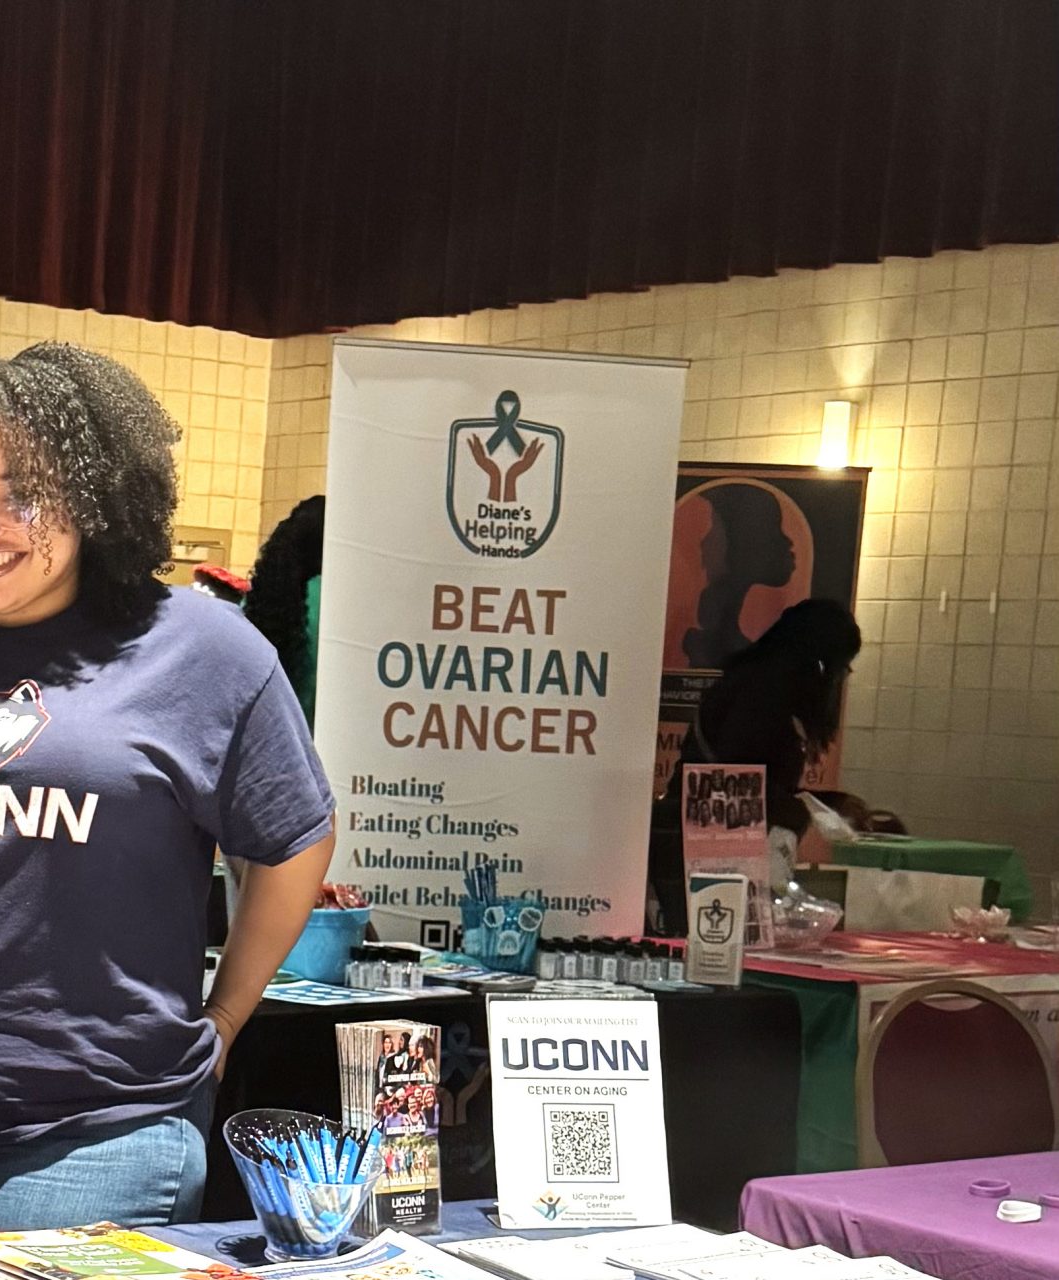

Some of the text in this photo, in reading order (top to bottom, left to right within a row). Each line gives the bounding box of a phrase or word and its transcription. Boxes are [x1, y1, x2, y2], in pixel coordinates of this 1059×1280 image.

[477, 503, 531, 521] Diane's
[465, 519, 537, 545] Helping
[481, 545, 520, 558] Hands
[432, 584, 567, 635] BEAT
[377, 641, 609, 697] OVARIAN
[383, 701, 597, 755] CANCER
[351, 775, 445, 803] Bloating
[349, 812, 519, 841] Eating Changes
[348, 848, 469, 871] Abdominal
[502, 1038, 649, 1071] UCONN
[528, 1086, 628, 1096] CENTER ON AGING
[391, 1195, 426, 1208] UCONN
[572, 1193, 626, 1203] UConn Pepper
[586, 1200, 611, 1209] Center
[395, 1206, 423, 1215] HEALTH
